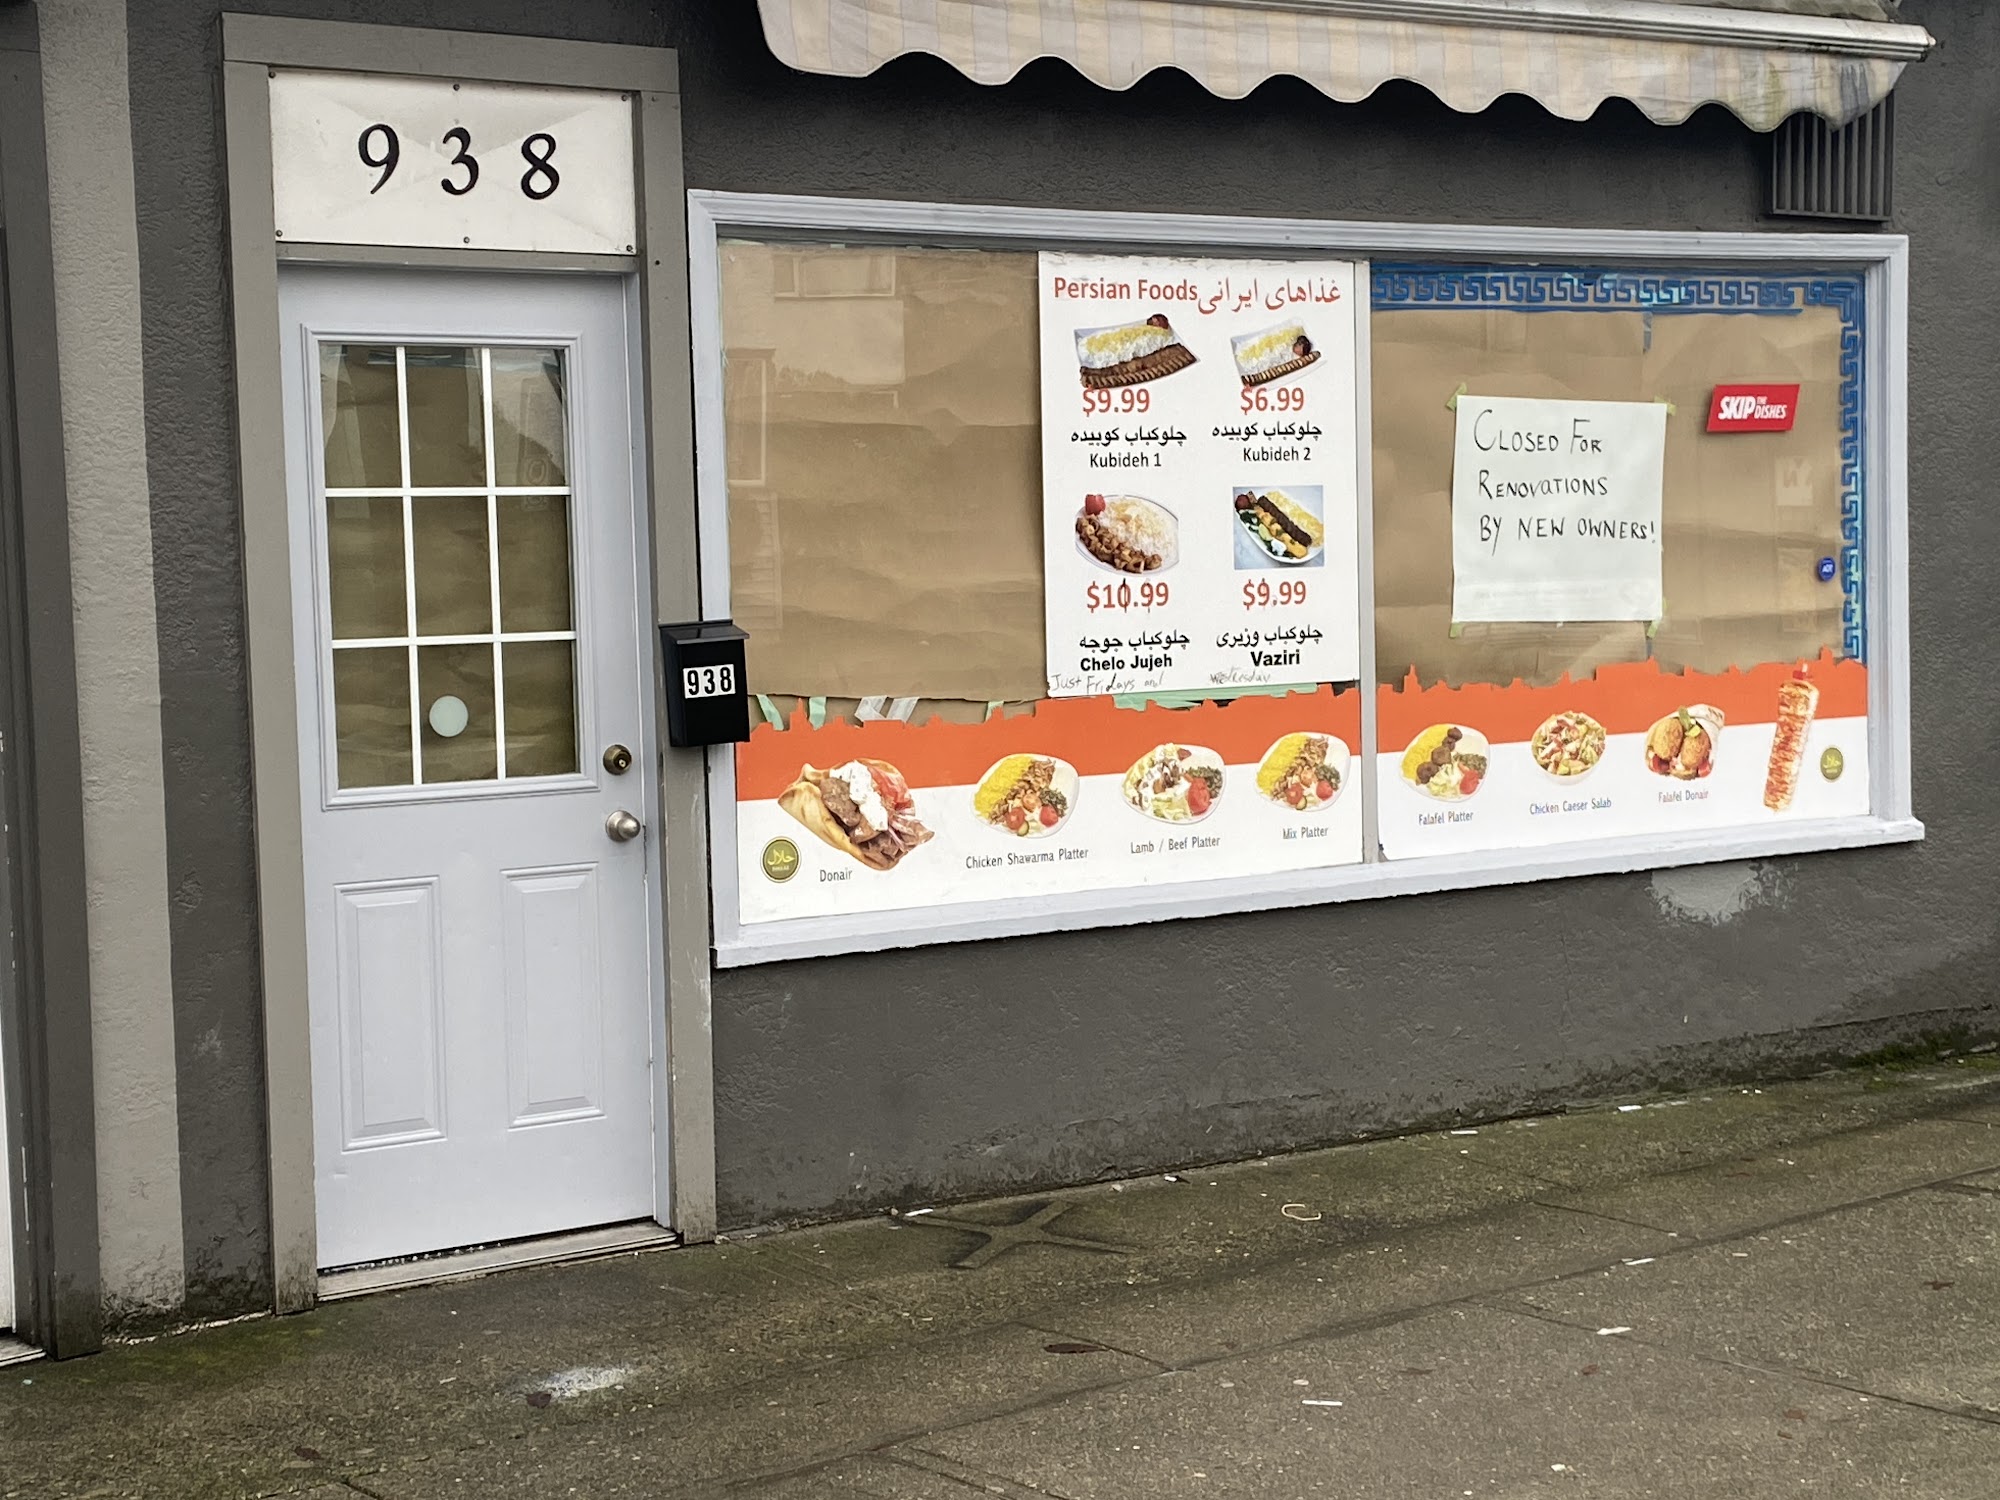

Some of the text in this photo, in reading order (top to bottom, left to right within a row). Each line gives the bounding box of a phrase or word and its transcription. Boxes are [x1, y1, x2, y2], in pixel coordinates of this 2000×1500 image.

[358, 123, 560, 200] 938
[1054, 276, 1198, 301] Persian Foods
[1197, 276, 1342, 315] غذاهای ایرانی
[1082, 385, 1151, 417] $9.99
[1240, 384, 1305, 415] $6.99
[1717, 395, 1757, 420] SKIP
[1753, 404, 1788, 419] DISHES
[1070, 425, 1187, 447] چلوکباب کوبیده
[1212, 420, 1322, 442] چلوکباب کوبیده
[1473, 409, 1603, 454] CLOSED FOR
[1089, 451, 1162, 468] Kubideh 1
[1243, 446, 1311, 462] Kubideh 2
[1480, 514, 1656, 556] BY NEW OWNERS!
[1086, 579, 1170, 614] $10.99
[1242, 578, 1307, 611] $9.99
[1079, 629, 1190, 654] چلوکباب جوجه
[1216, 624, 1323, 648] چلوکباب وزیری
[1080, 653, 1173, 672] Chelo Jujeh
[1250, 649, 1300, 667] Vaziri
[687, 666, 732, 696] 938
[1051, 673, 1082, 691] Just
[1086, 672, 1136, 695] Fridays
[1529, 802, 1559, 815] Chicken
[1562, 800, 1588, 812] Caeser
[1658, 789, 1709, 803] Falafel Donair
[1418, 810, 1474, 826] Falafel Platter
[1282, 825, 1329, 840] Mix Platter
[1130, 834, 1221, 855] Lamb / Beef Platter
[965, 846, 1089, 870] Chicken Shawarma Platter
[819, 868, 853, 883] Donair
